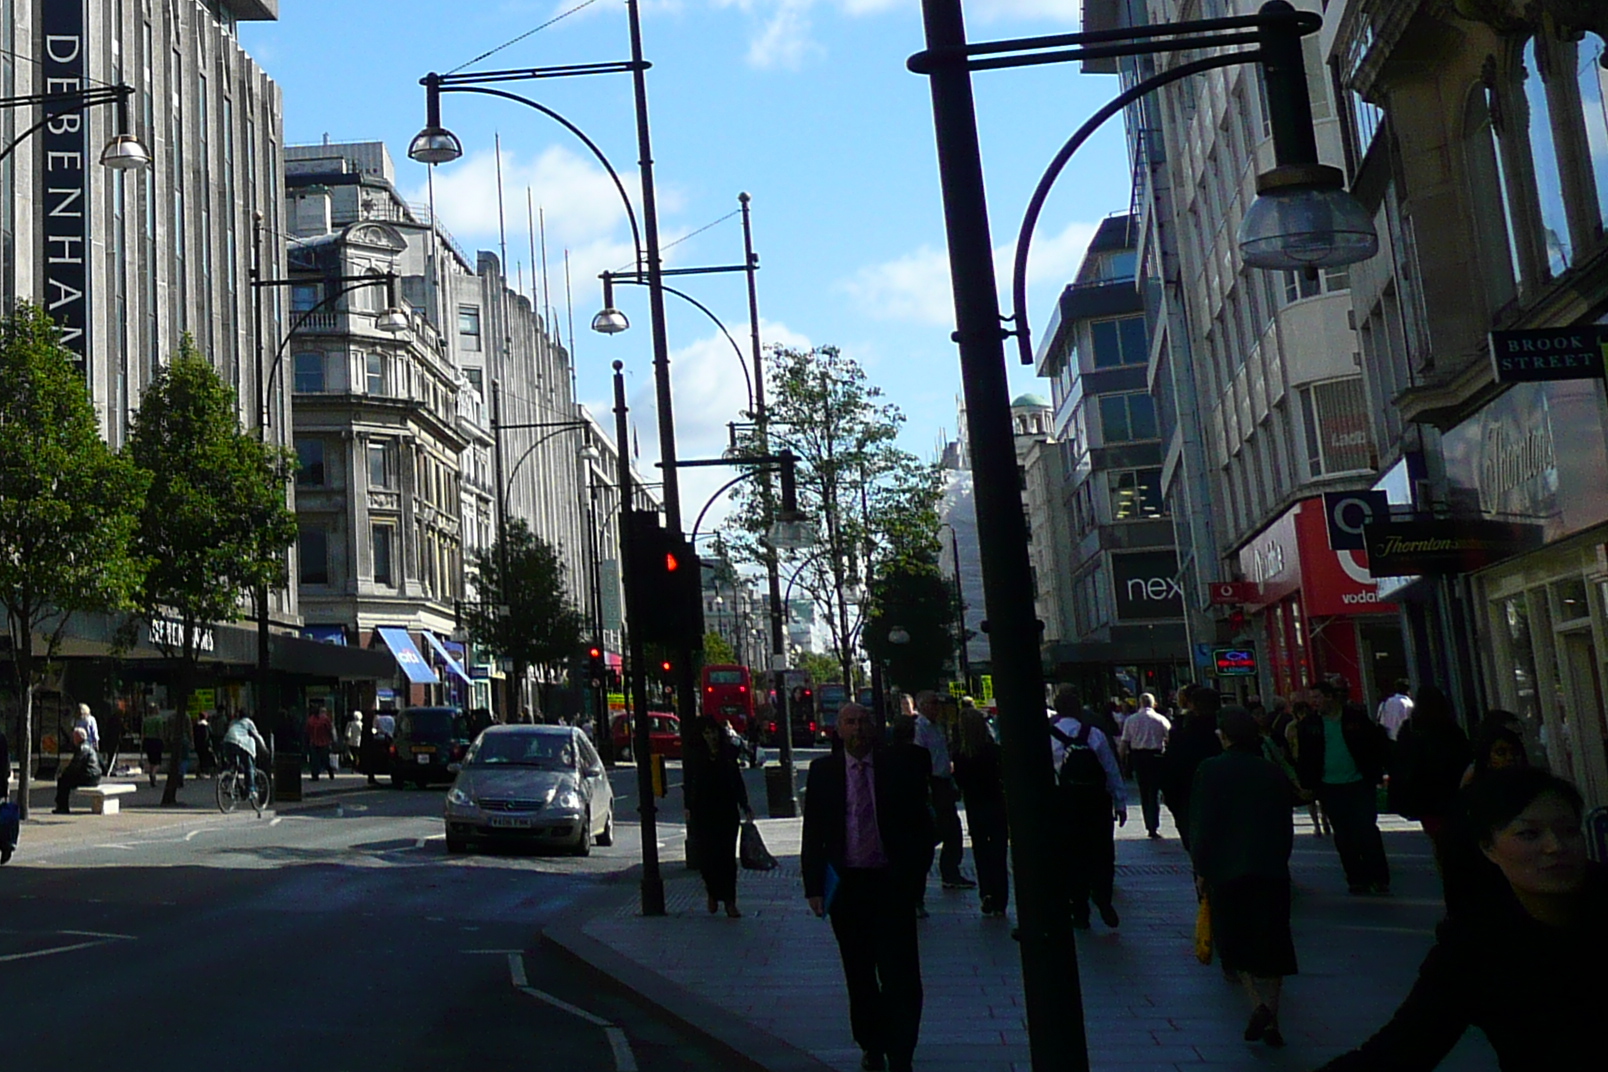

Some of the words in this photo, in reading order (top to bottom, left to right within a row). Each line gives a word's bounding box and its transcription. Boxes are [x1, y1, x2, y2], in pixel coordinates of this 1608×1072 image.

[1507, 336, 1584, 353] BROOK
[1501, 353, 1595, 371] STREET
[1375, 535, 1459, 559] Thorntons
